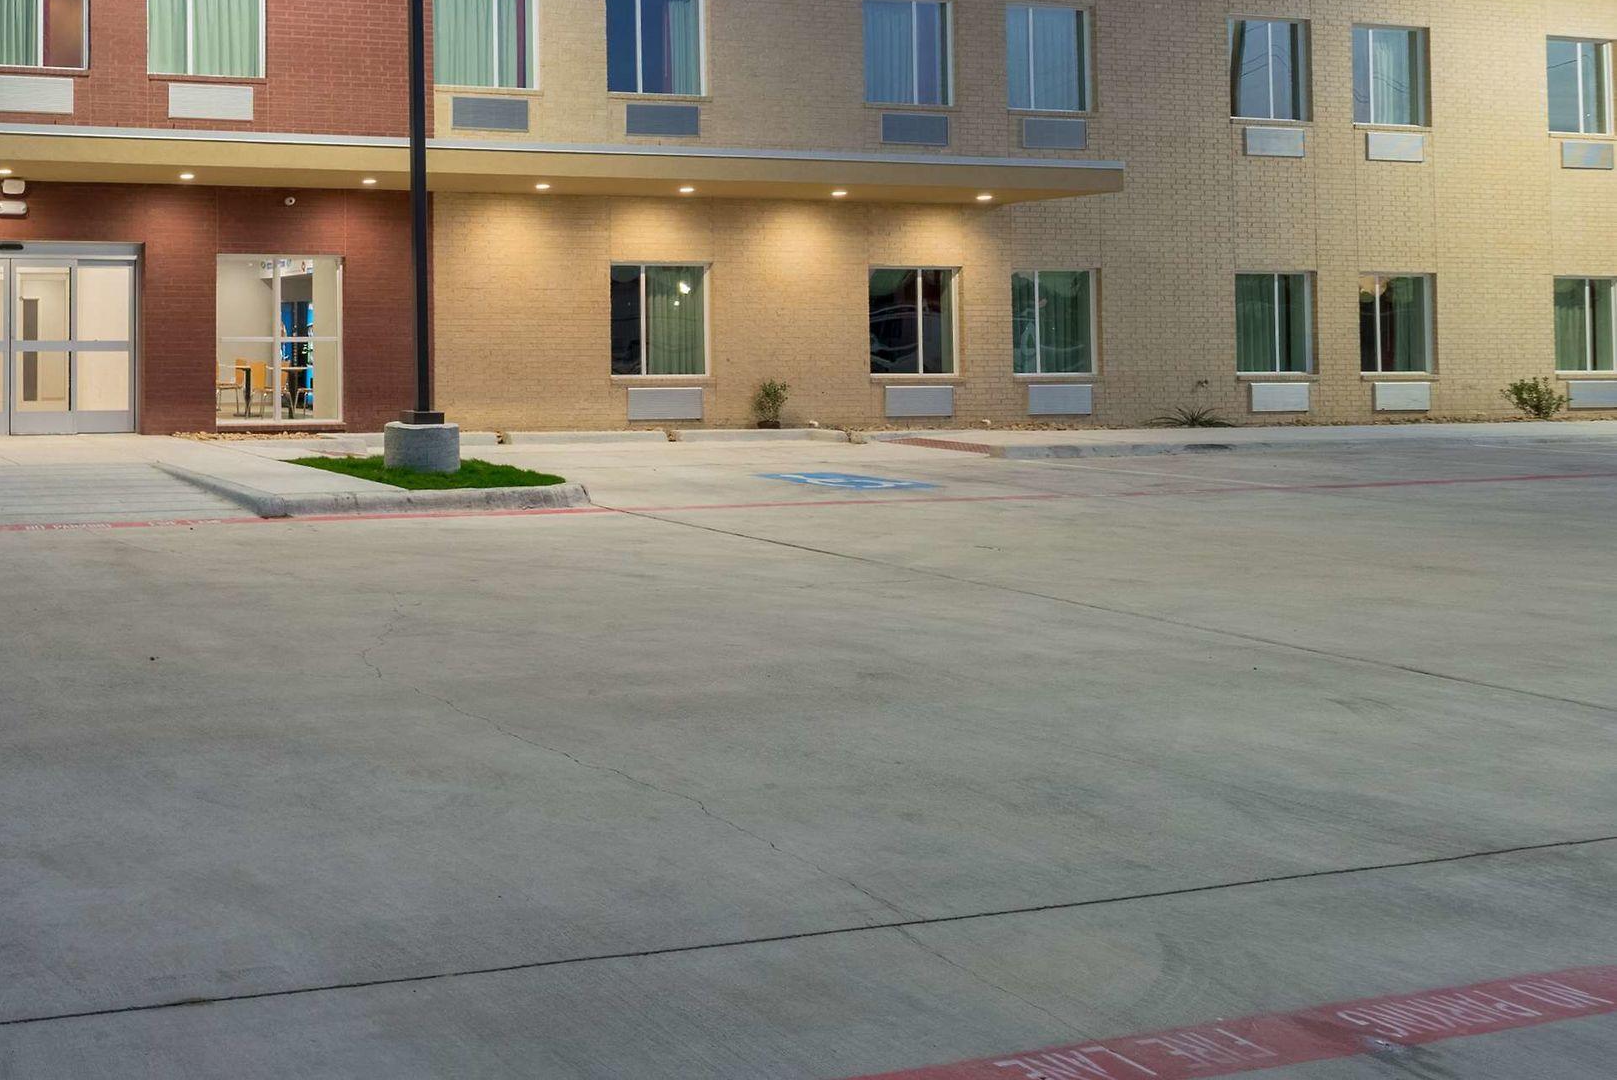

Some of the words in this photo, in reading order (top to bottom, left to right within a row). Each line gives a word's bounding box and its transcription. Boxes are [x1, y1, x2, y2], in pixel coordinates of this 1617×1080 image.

[1336, 989, 1543, 1038] PARKING
[1509, 977, 1614, 1009] NO
[1135, 1027, 1279, 1069] FIRE
